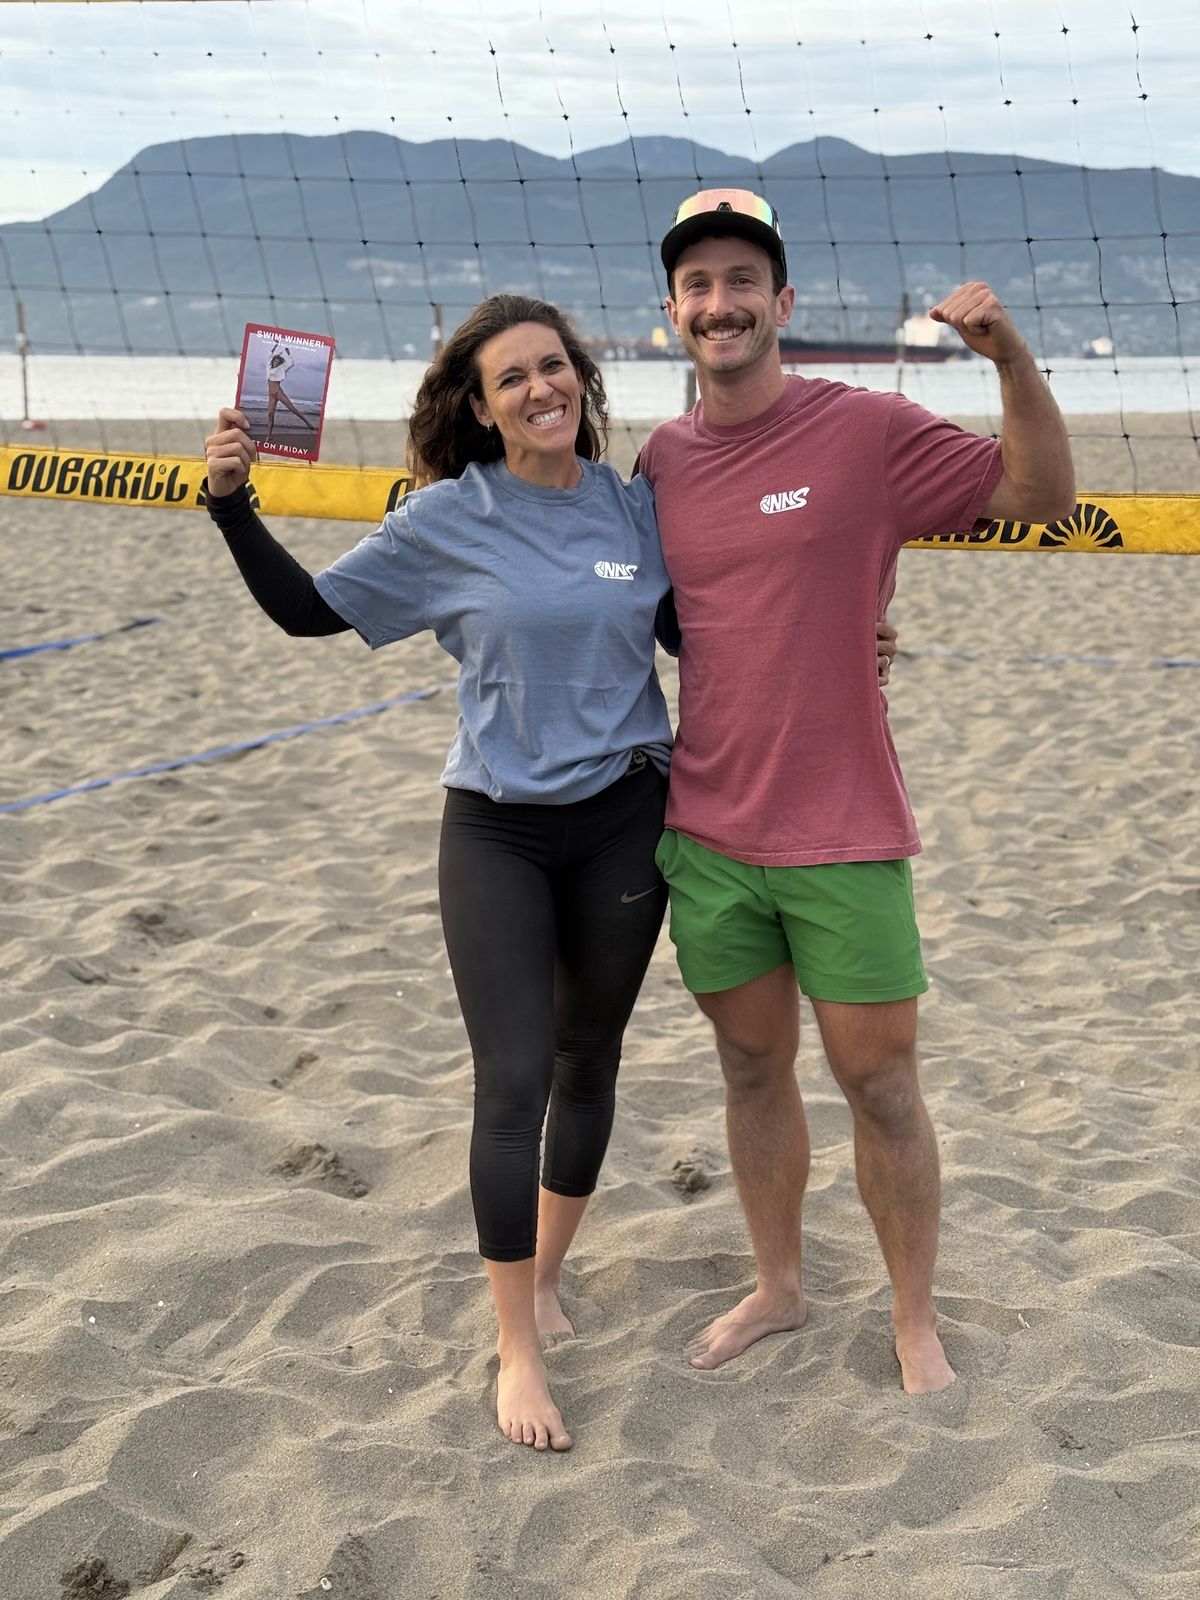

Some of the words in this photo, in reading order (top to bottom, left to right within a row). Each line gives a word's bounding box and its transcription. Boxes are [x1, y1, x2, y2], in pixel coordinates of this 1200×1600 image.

[256, 330, 282, 340] SWIM
[285, 335, 325, 348] WINNER!
[279, 445, 308, 454] FRIDAY
